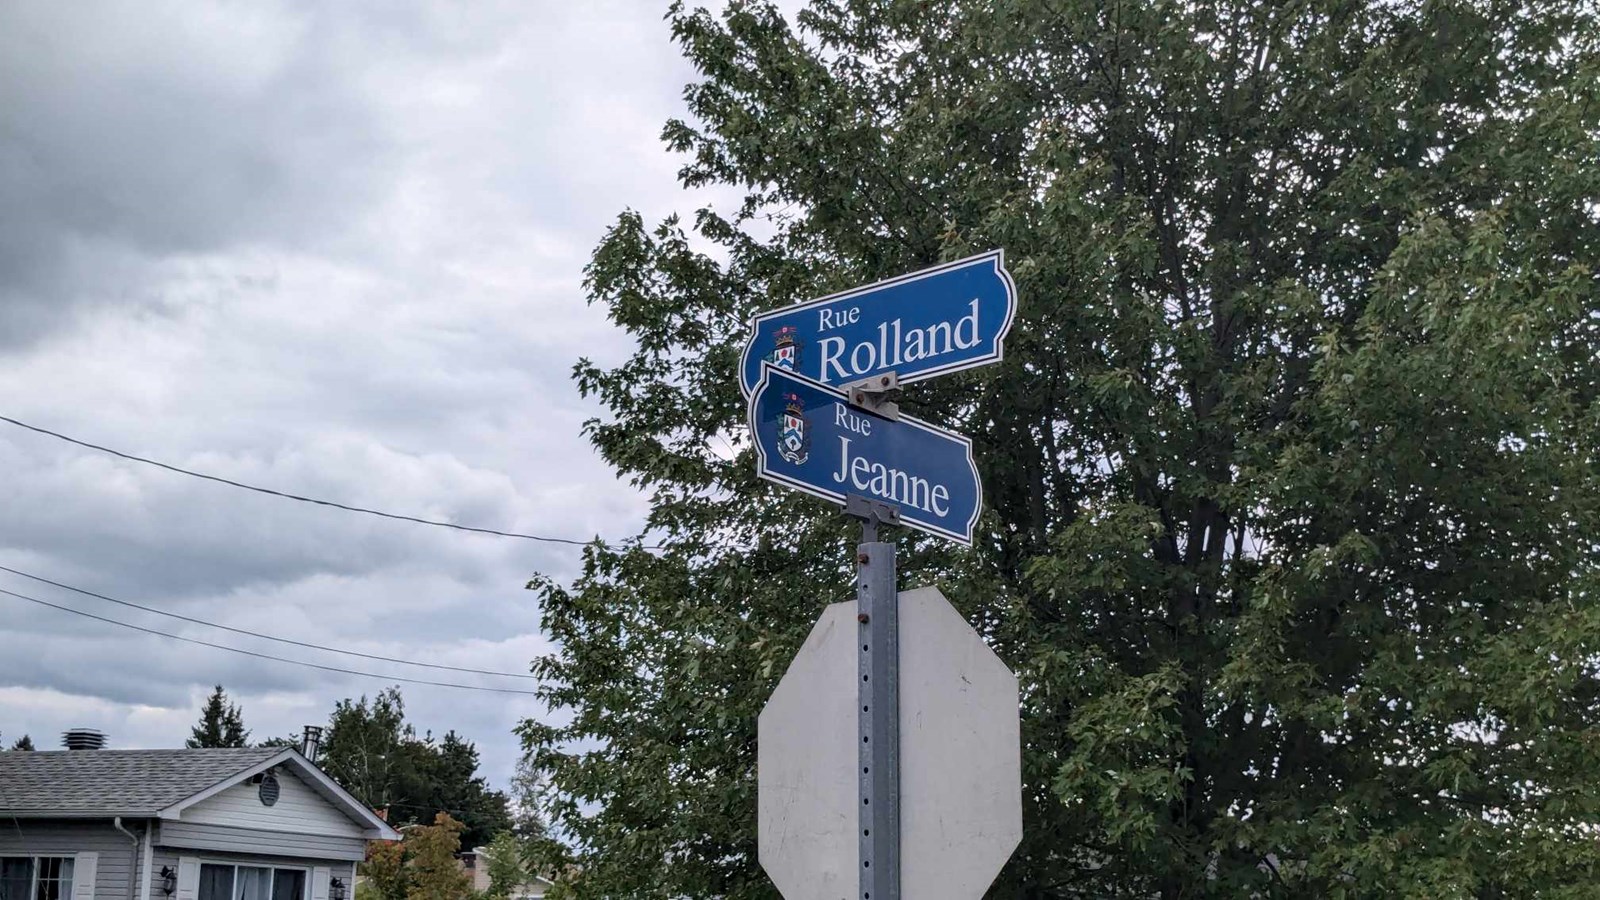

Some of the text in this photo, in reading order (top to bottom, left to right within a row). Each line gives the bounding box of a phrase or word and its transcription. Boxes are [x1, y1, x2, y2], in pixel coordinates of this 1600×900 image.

[817, 306, 860, 333] Rue
[817, 298, 982, 384] Rolland
[834, 402, 871, 436] Rue
[833, 435, 949, 517] Jeanne
